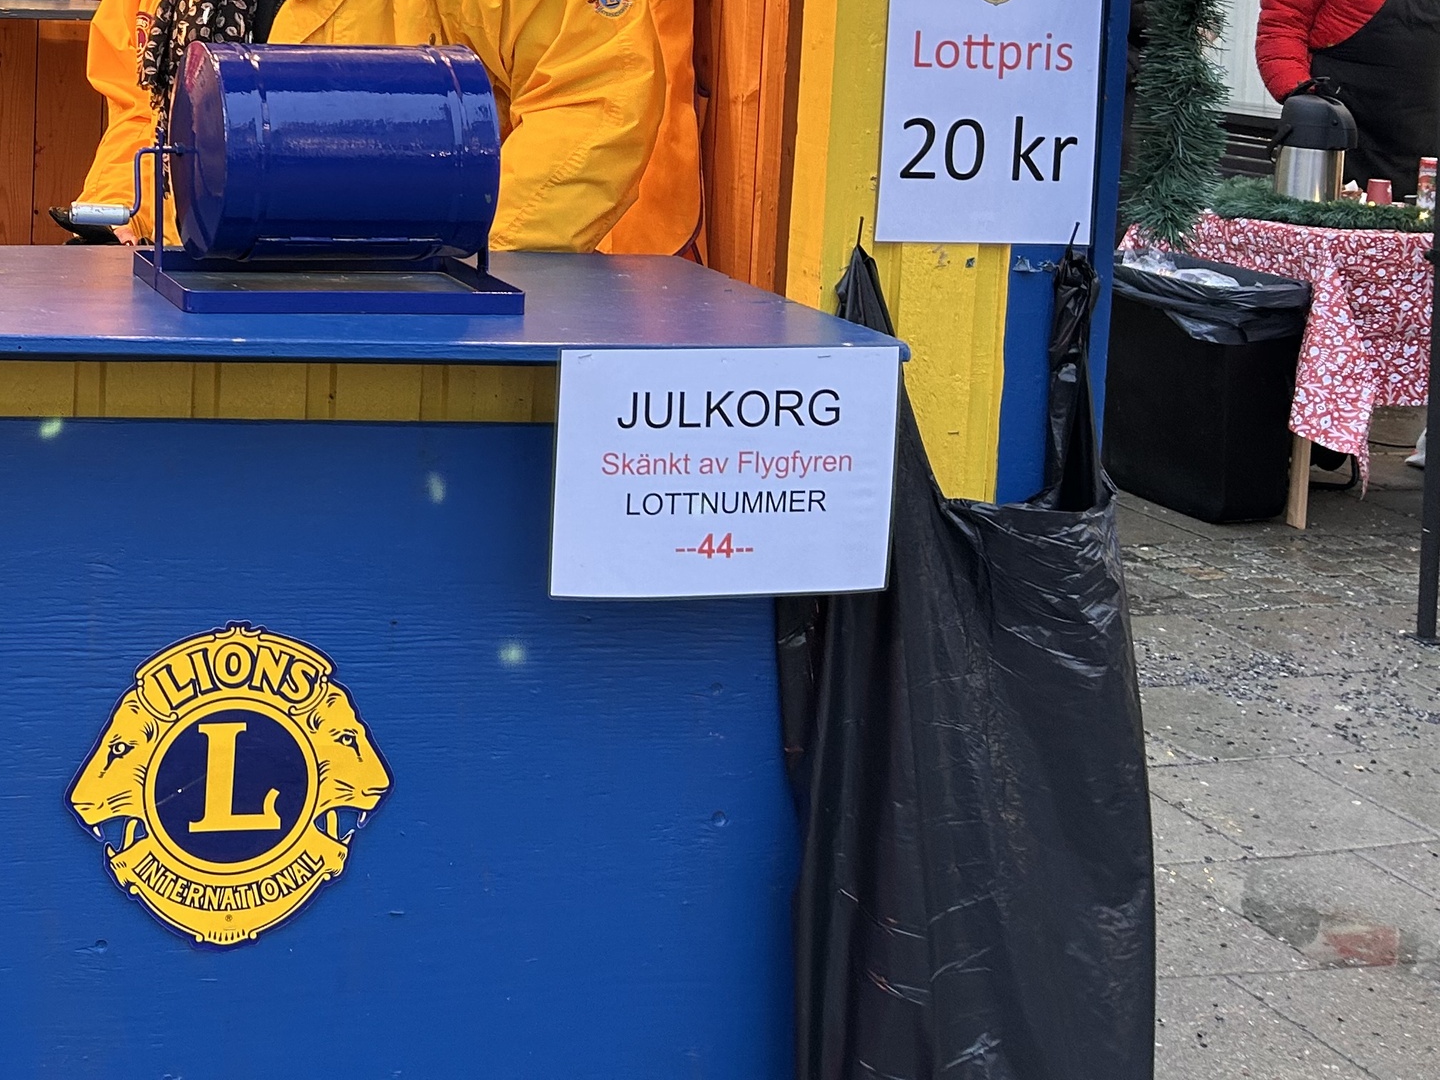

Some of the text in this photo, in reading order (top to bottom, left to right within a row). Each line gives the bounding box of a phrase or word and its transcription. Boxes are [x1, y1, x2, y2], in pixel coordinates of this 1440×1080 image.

[913, 30, 1074, 79] Lottpris
[899, 116, 1078, 182] 20 kr
[616, 389, 841, 430] JULKORG
[601, 450, 853, 480] Skänkt av Flygfyren
[626, 489, 827, 516] LOTTNUMMER
[675, 533, 754, 559] --44--
[153, 641, 321, 709] LIONS
[188, 722, 281, 834] L
[134, 849, 326, 913] INTERNATIONAL
